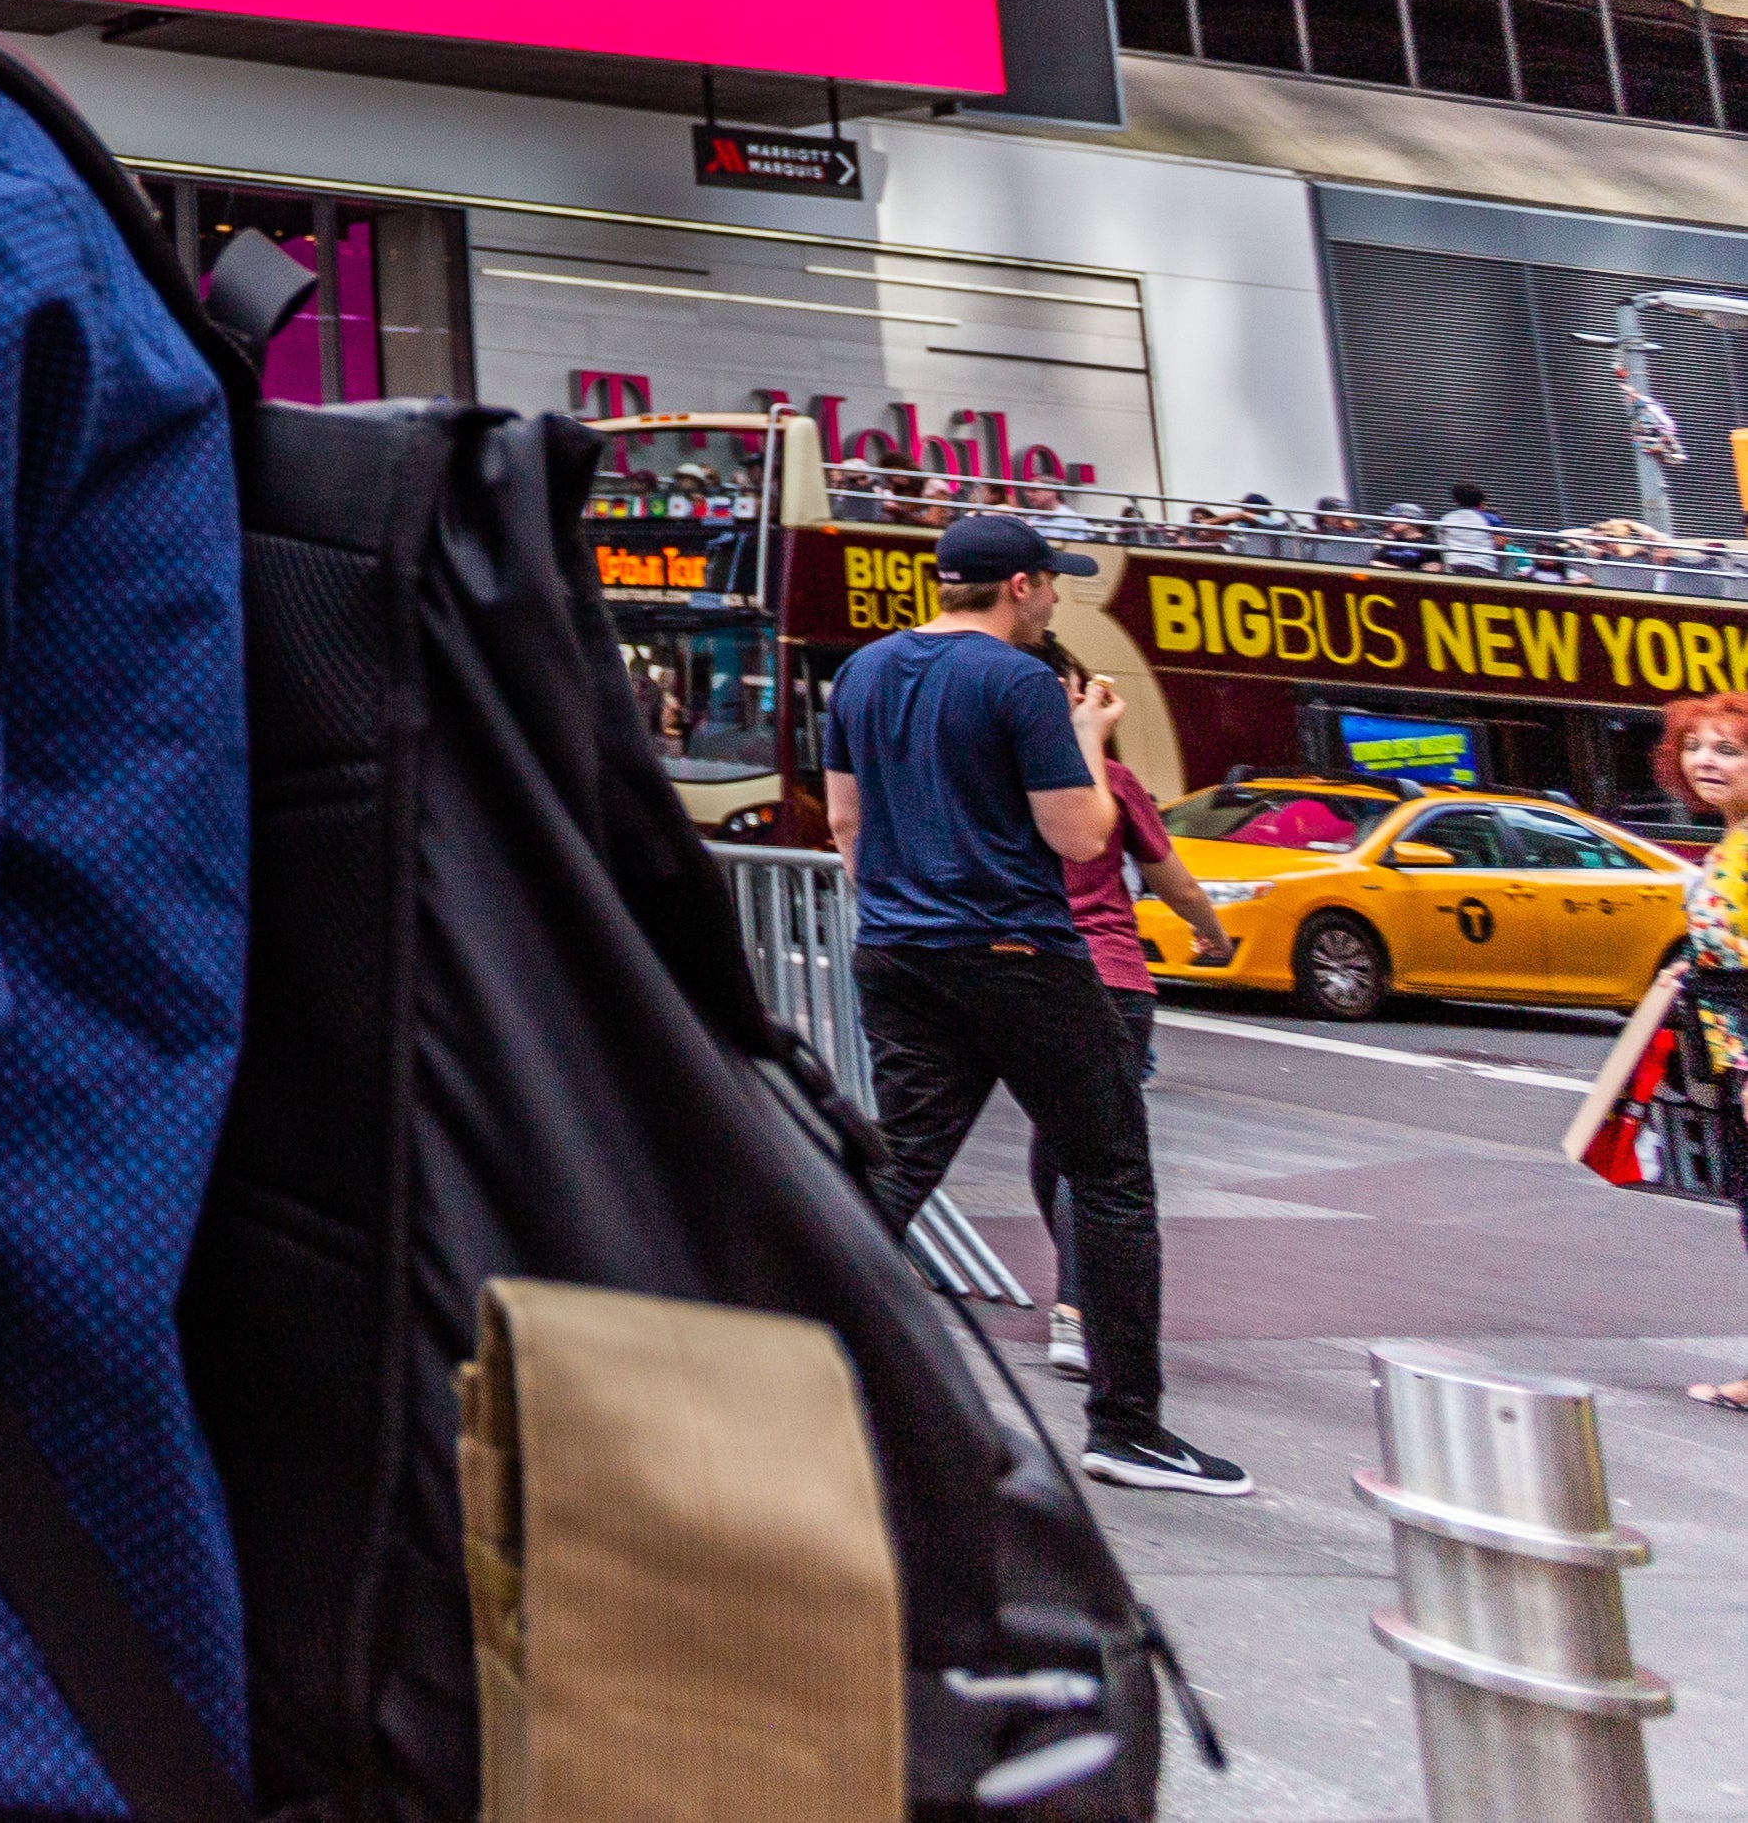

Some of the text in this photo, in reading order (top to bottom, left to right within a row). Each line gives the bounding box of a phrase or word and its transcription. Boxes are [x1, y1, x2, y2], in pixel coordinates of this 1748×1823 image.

[747, 144, 830, 163] MARRIOTT
[748, 160, 823, 179] MARQUIS
[844, 546, 913, 591] BIG
[848, 590, 915, 630] BUS
[1420, 601, 1580, 682] NEW
